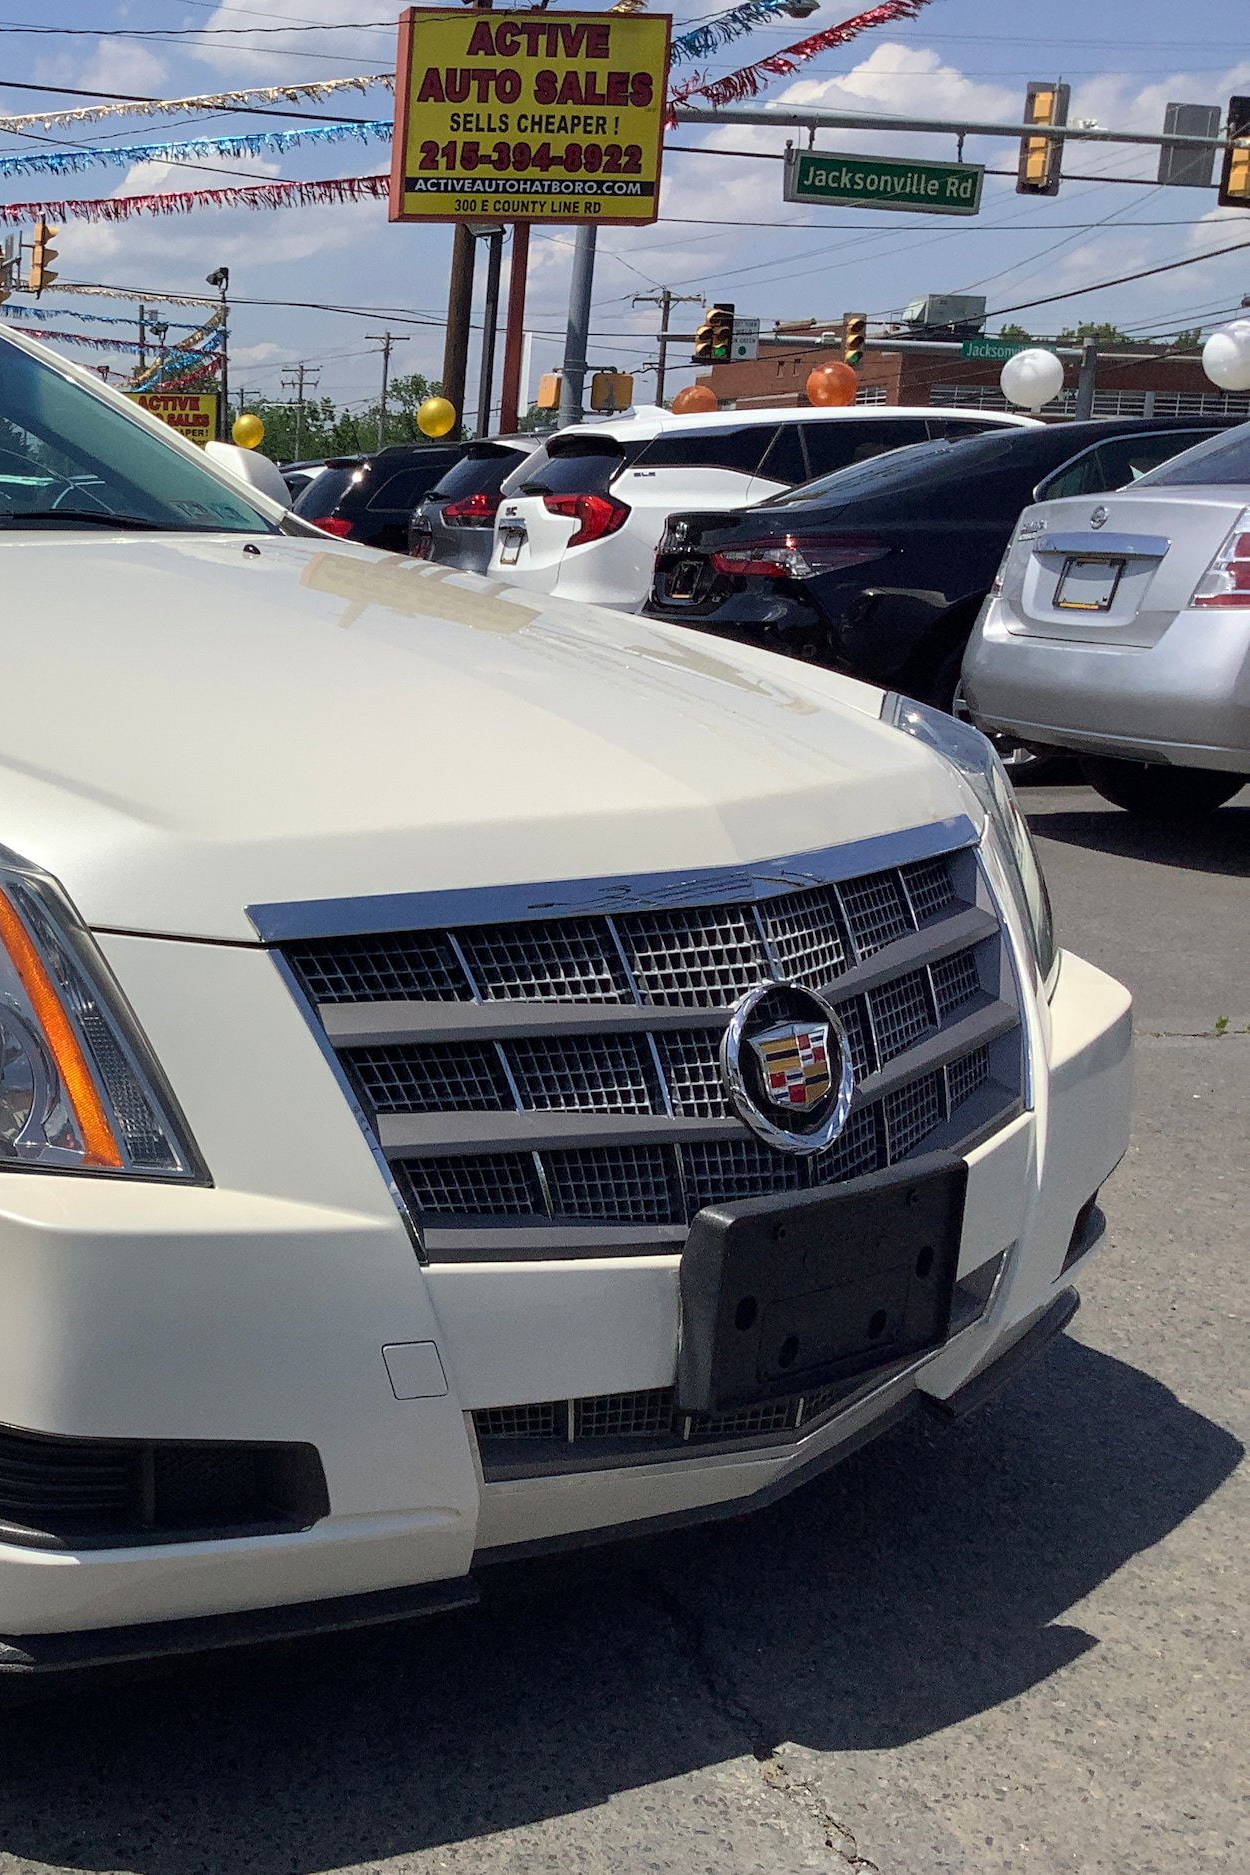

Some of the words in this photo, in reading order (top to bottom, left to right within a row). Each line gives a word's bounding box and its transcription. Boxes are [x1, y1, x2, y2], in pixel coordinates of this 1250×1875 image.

[466, 21, 610, 58] ACTIVE
[416, 67, 522, 104] AUTO
[534, 69, 653, 107] SALES
[450, 113, 509, 133] SELLS
[517, 114, 607, 135] CHEAPER
[419, 140, 642, 174] 215-394-8922
[414, 178, 641, 196] ACTIVEAUTOHATBORO.COM
[803, 166, 940, 196] Jacksonville
[946, 177, 972, 199] Rd
[454, 199, 476, 212] 300
[481, 199, 489, 212] E
[493, 199, 546, 213] COUNTY
[551, 201, 579, 214] LINE
[584, 201, 601, 214] RD
[138, 396, 200, 411] ACTIVE
[167, 414, 209, 427] SALES
